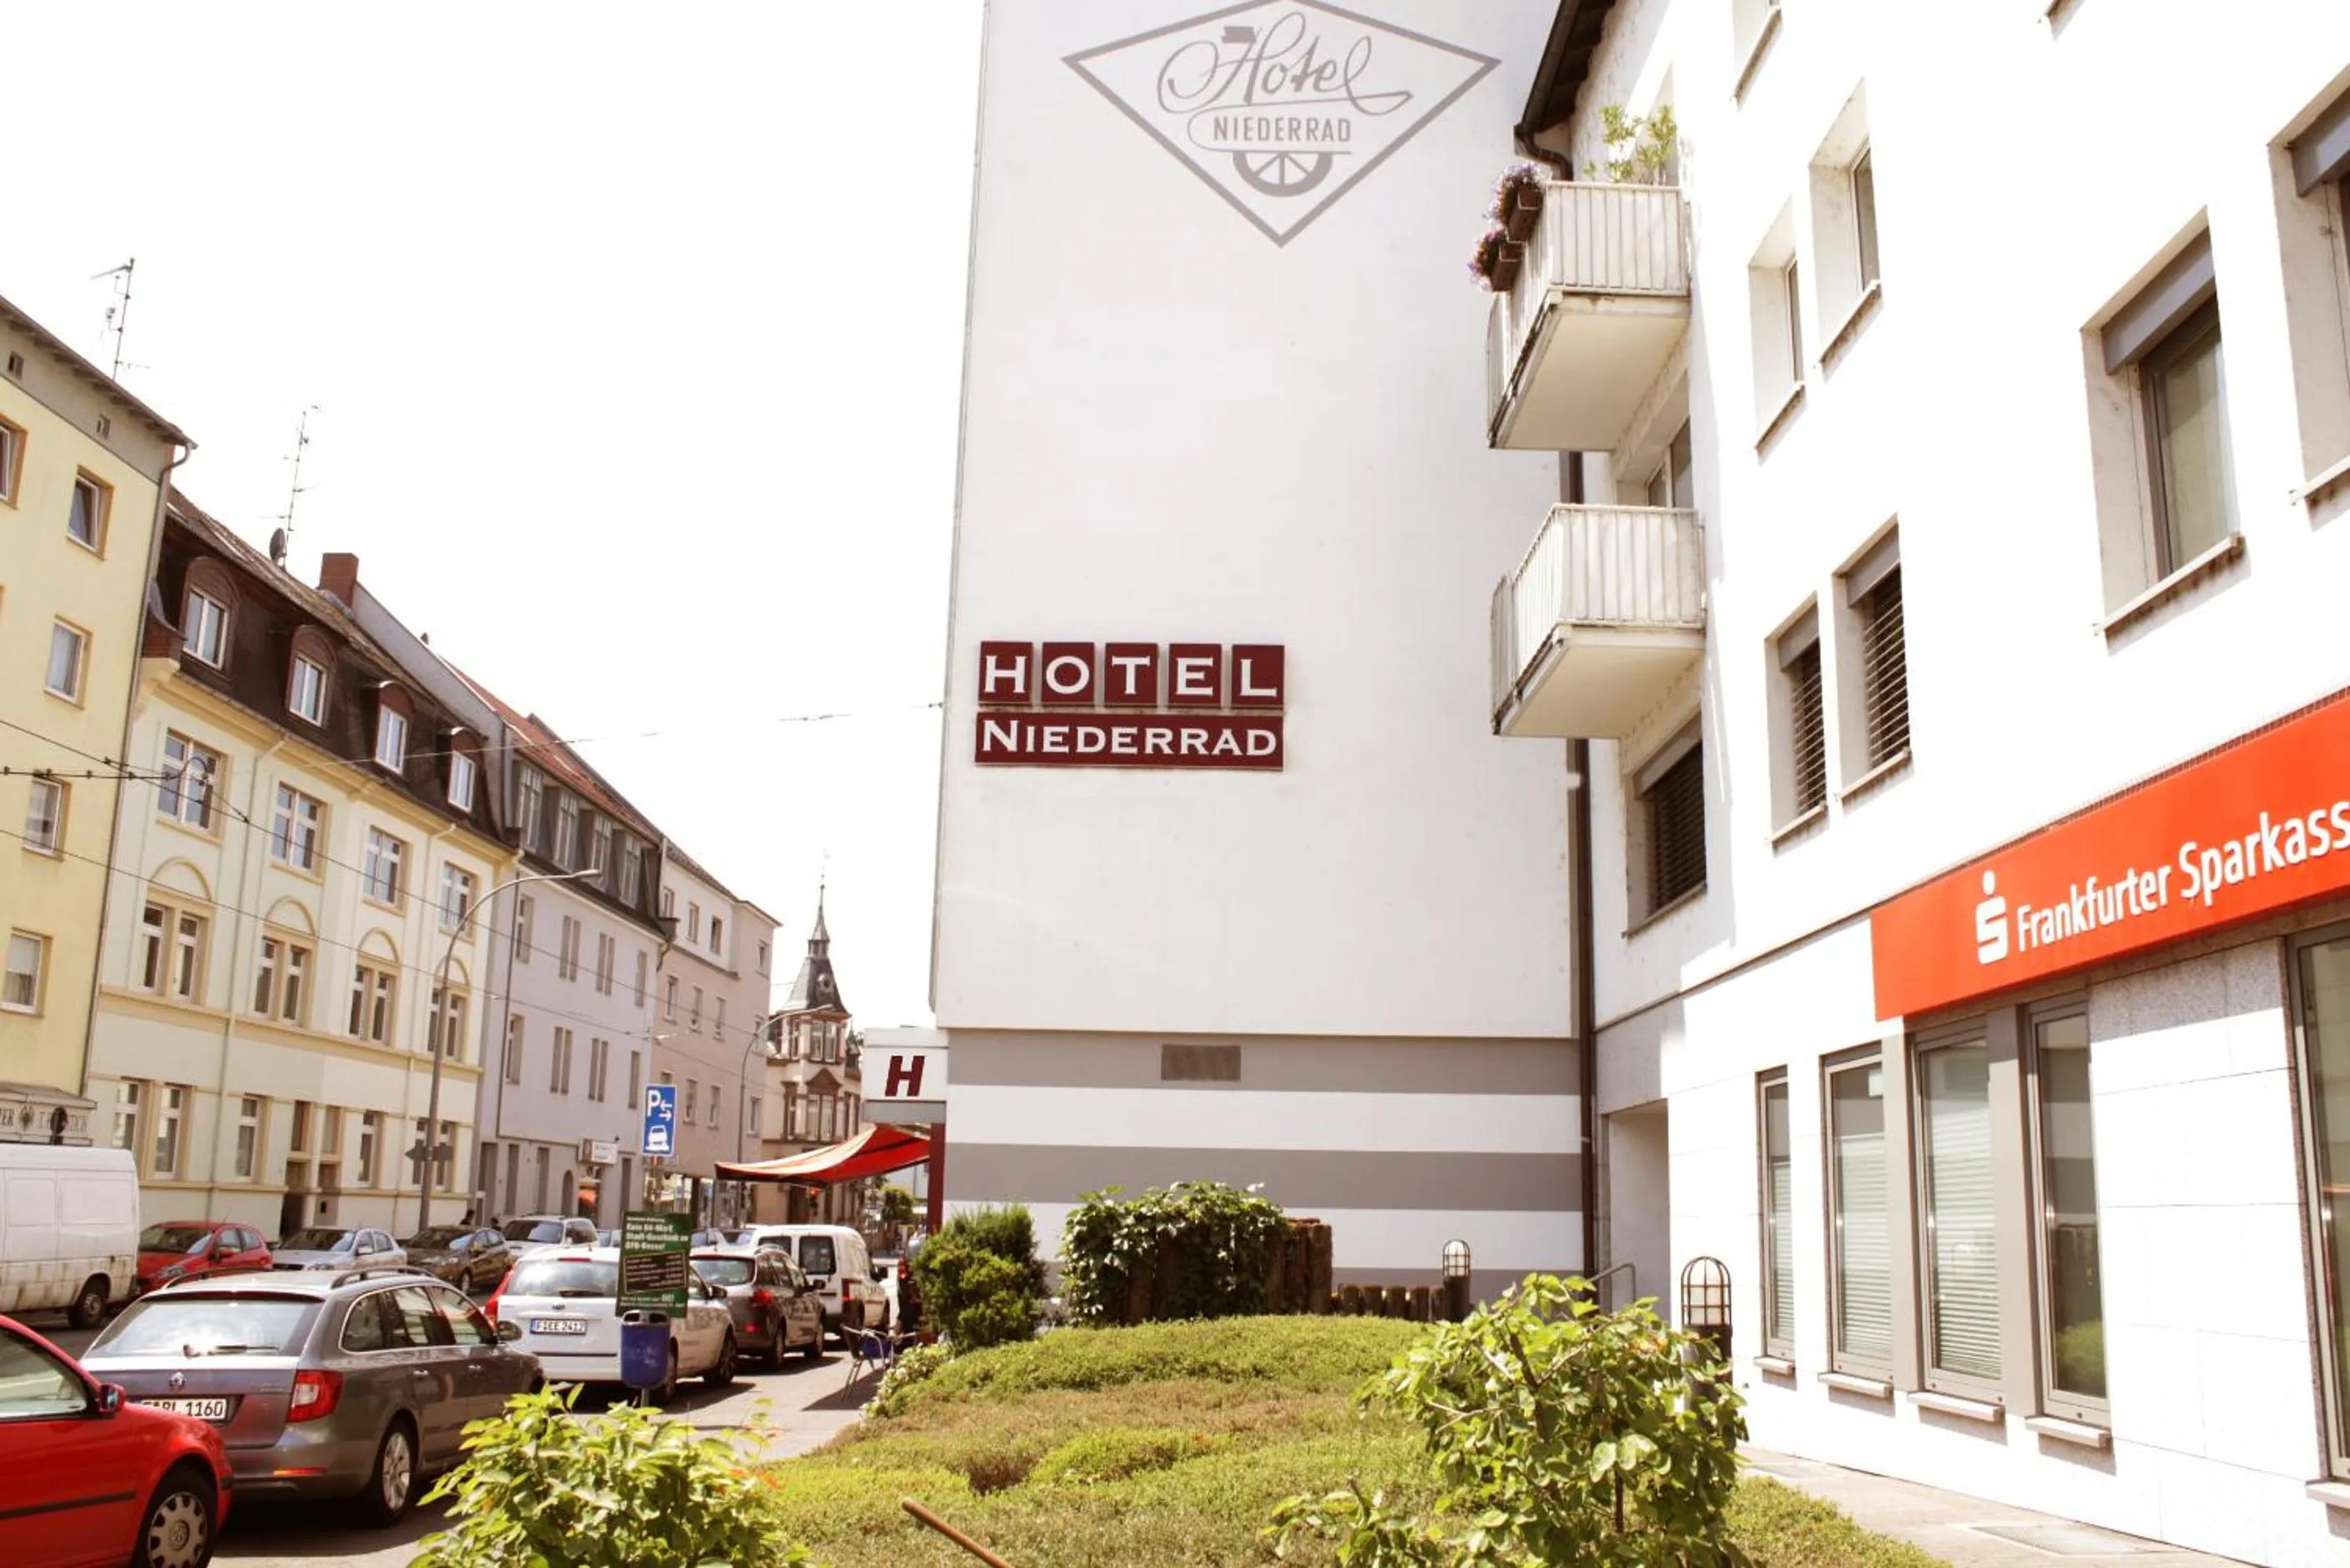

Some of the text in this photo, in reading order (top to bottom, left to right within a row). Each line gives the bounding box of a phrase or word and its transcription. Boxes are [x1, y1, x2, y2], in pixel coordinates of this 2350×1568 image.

[1157, 12, 1414, 115] Hotel
[1213, 116, 1352, 143] NIEDERRAD
[983, 655, 1278, 698] HOTEL
[981, 719, 1278, 757] NIEDERRAD
[2016, 865, 2172, 953] Frankfurter
[885, 1055, 925, 1097] H
[648, 1089, 662, 1117] P
[186, 1400, 224, 1417] 1160
